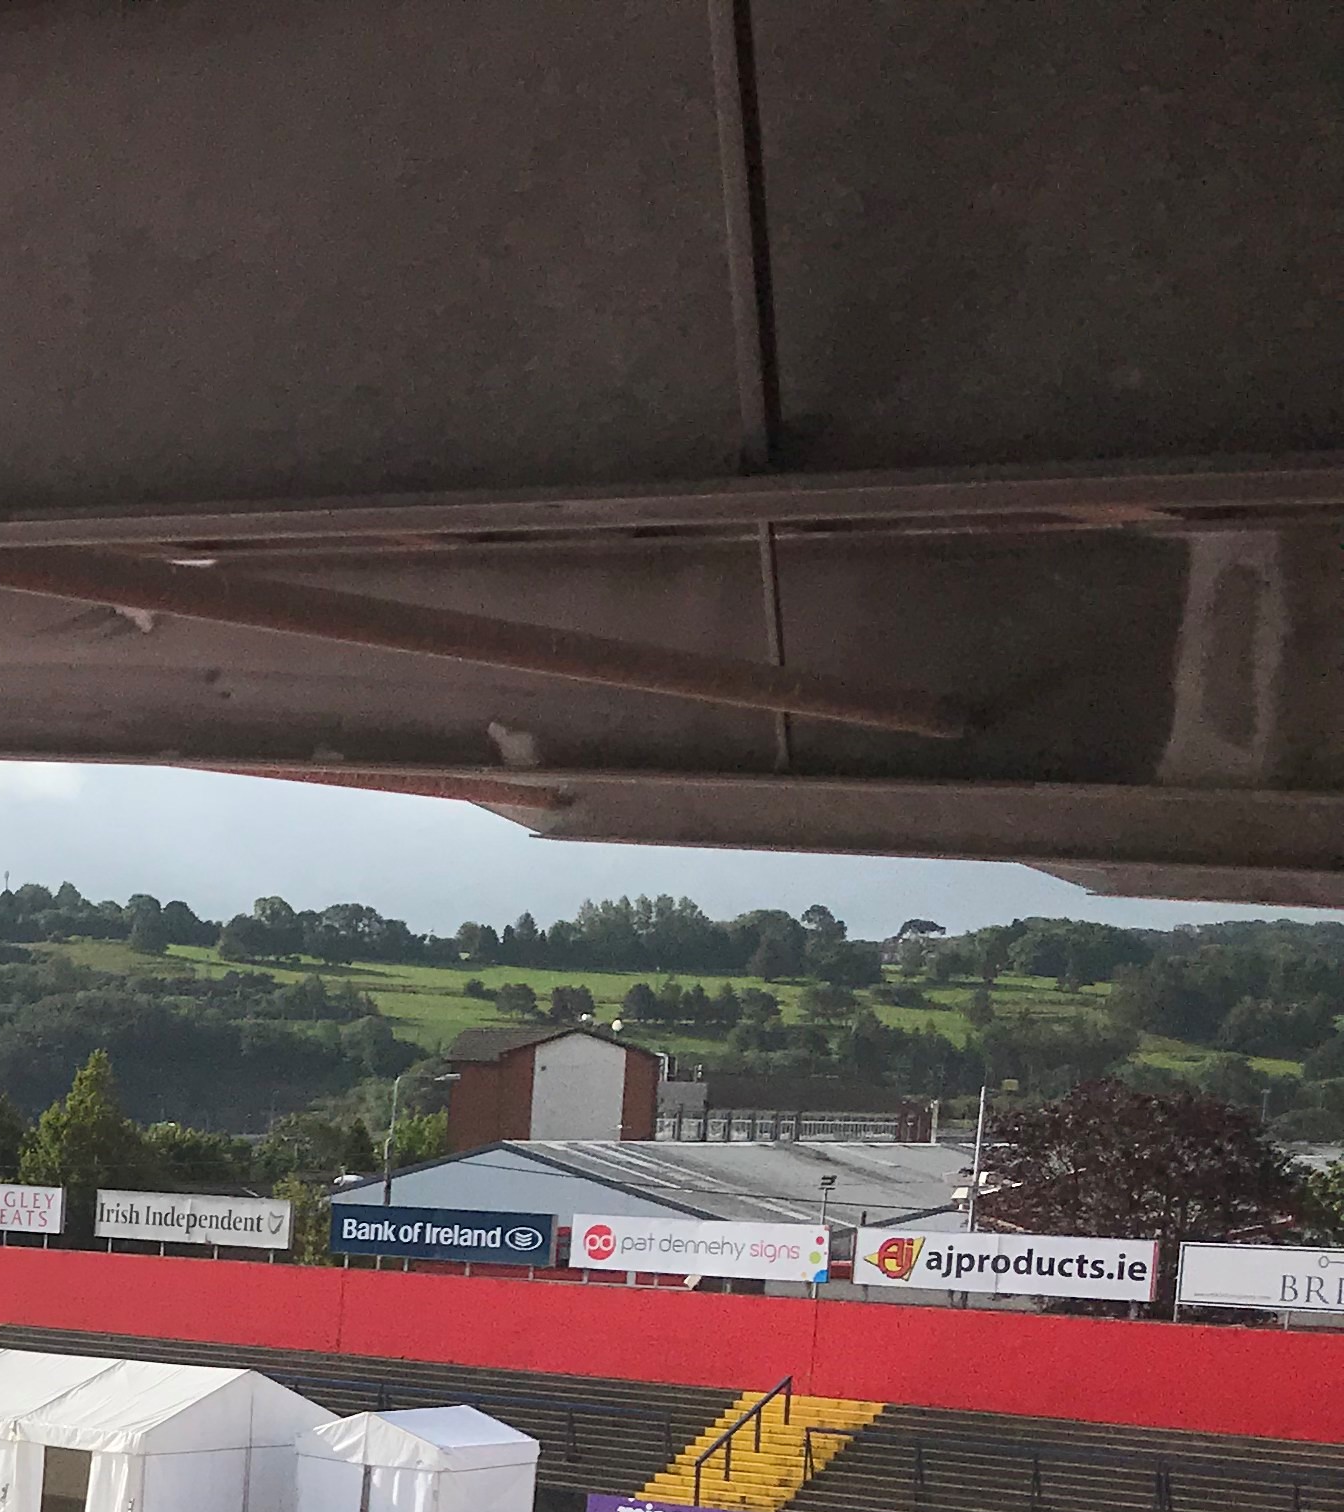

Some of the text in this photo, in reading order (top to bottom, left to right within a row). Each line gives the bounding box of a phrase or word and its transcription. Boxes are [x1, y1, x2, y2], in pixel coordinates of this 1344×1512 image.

[98, 1203, 265, 1234] Irish Independent
[342, 1218, 502, 1248] Bank of Ireland
[621, 1233, 800, 1263] pat dennehy signs
[926, 1245, 1147, 1281] ajproducts.ie
